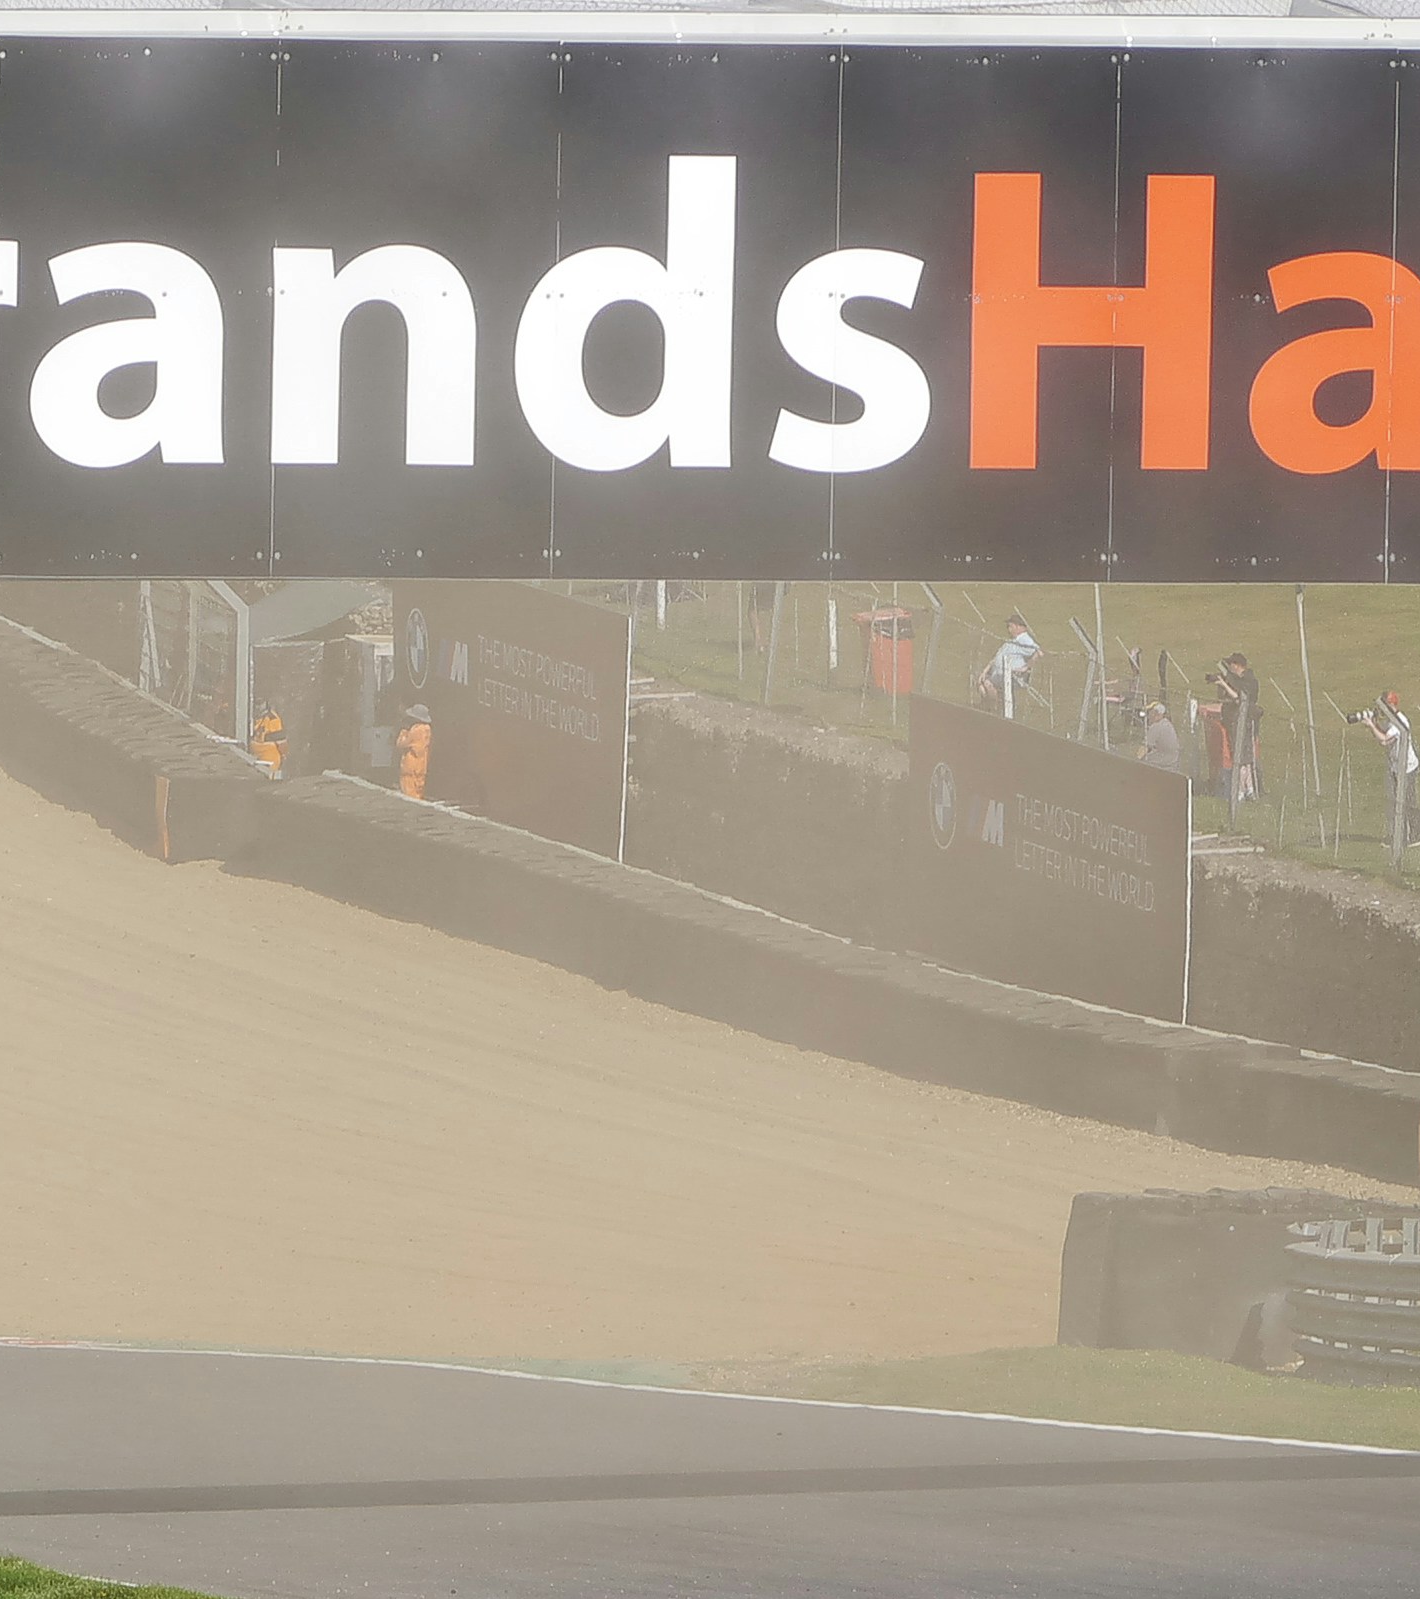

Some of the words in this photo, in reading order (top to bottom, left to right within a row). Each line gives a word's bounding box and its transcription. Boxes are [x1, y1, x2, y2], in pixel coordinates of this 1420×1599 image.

[503, 645, 534, 679] MOST
[537, 653, 597, 701] POWERFUL
[1016, 793, 1041, 831] THE
[1043, 802, 1080, 841] MOST
[1082, 816, 1152, 867] POWERFUL
[1015, 838, 1061, 880] LETTER
[1079, 858, 1106, 896] THE
